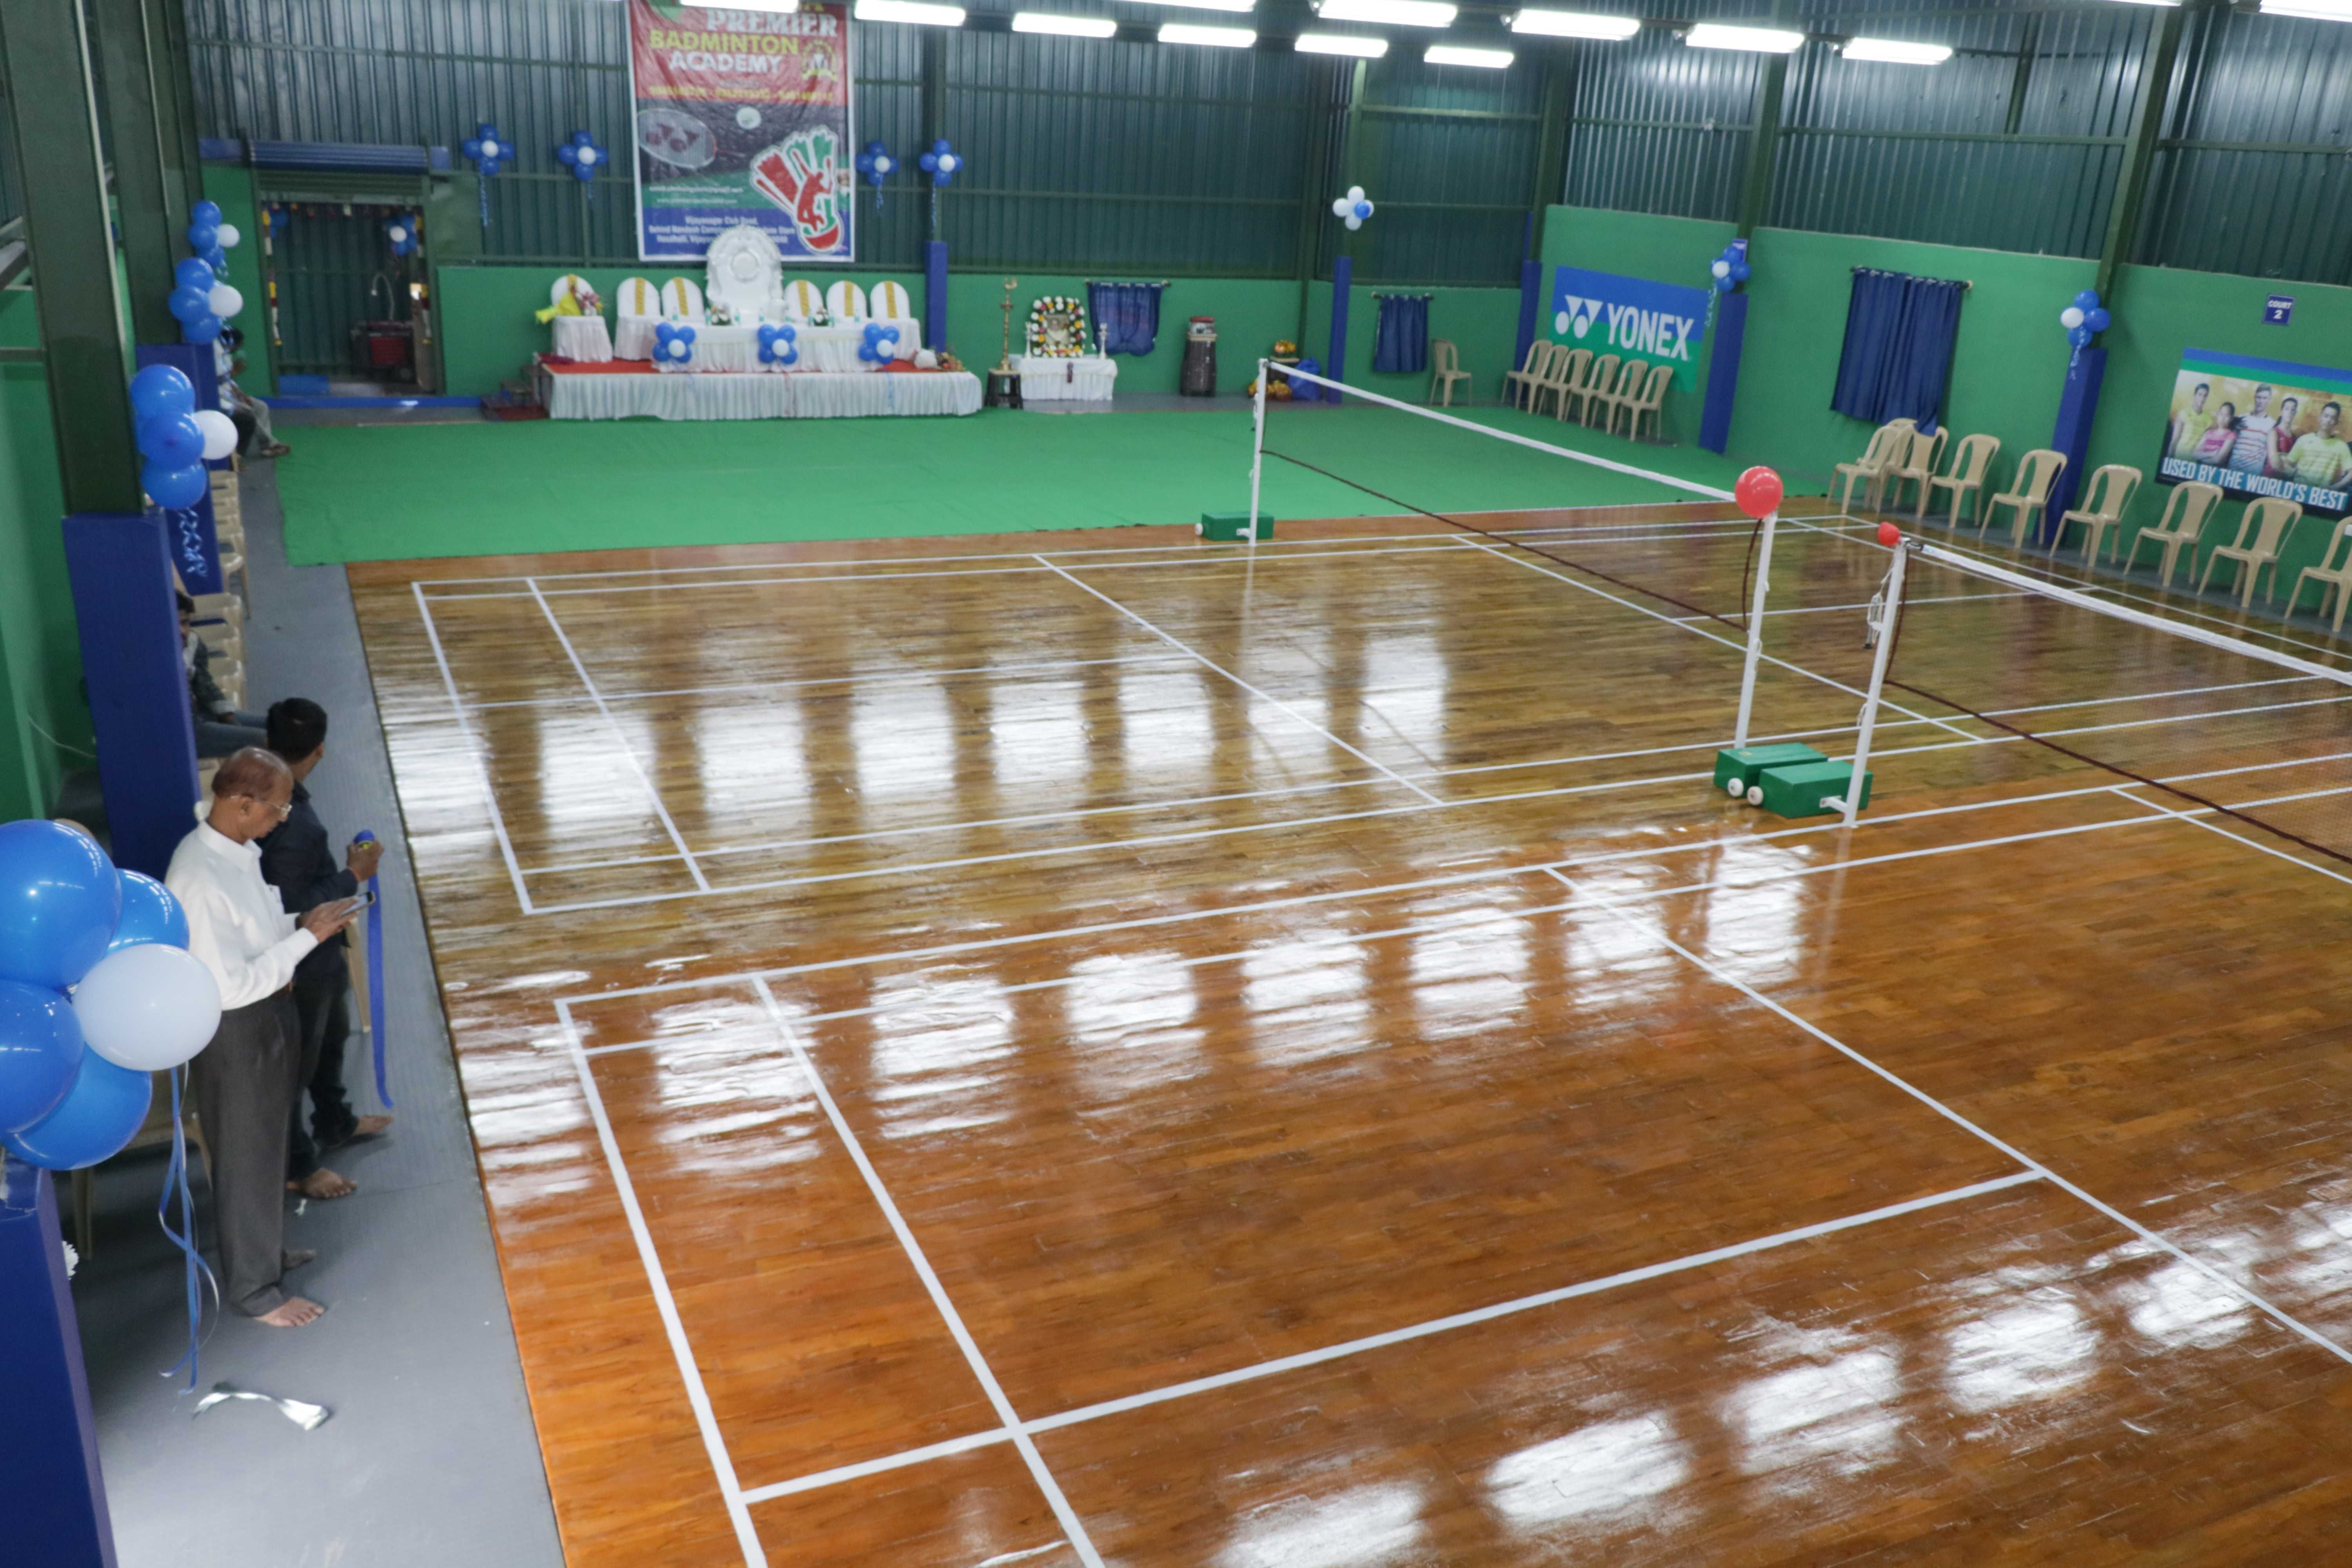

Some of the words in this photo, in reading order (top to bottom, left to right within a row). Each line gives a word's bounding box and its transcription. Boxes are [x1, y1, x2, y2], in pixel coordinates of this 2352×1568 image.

[706, 9, 837, 37] PREMIER
[649, 29, 799, 55] BADMINTON
[670, 51, 783, 73] ACADEMY
[2268, 300, 2292, 309] COURT
[2273, 310, 2283, 319] 2
[1607, 303, 1694, 361] YONEX
[2162, 457, 2196, 479] USED
[2198, 466, 2217, 483] BY
[2218, 468, 2244, 489] THE
[2246, 475, 2307, 501] WORLD'S
[2308, 487, 2347, 510] BEST
